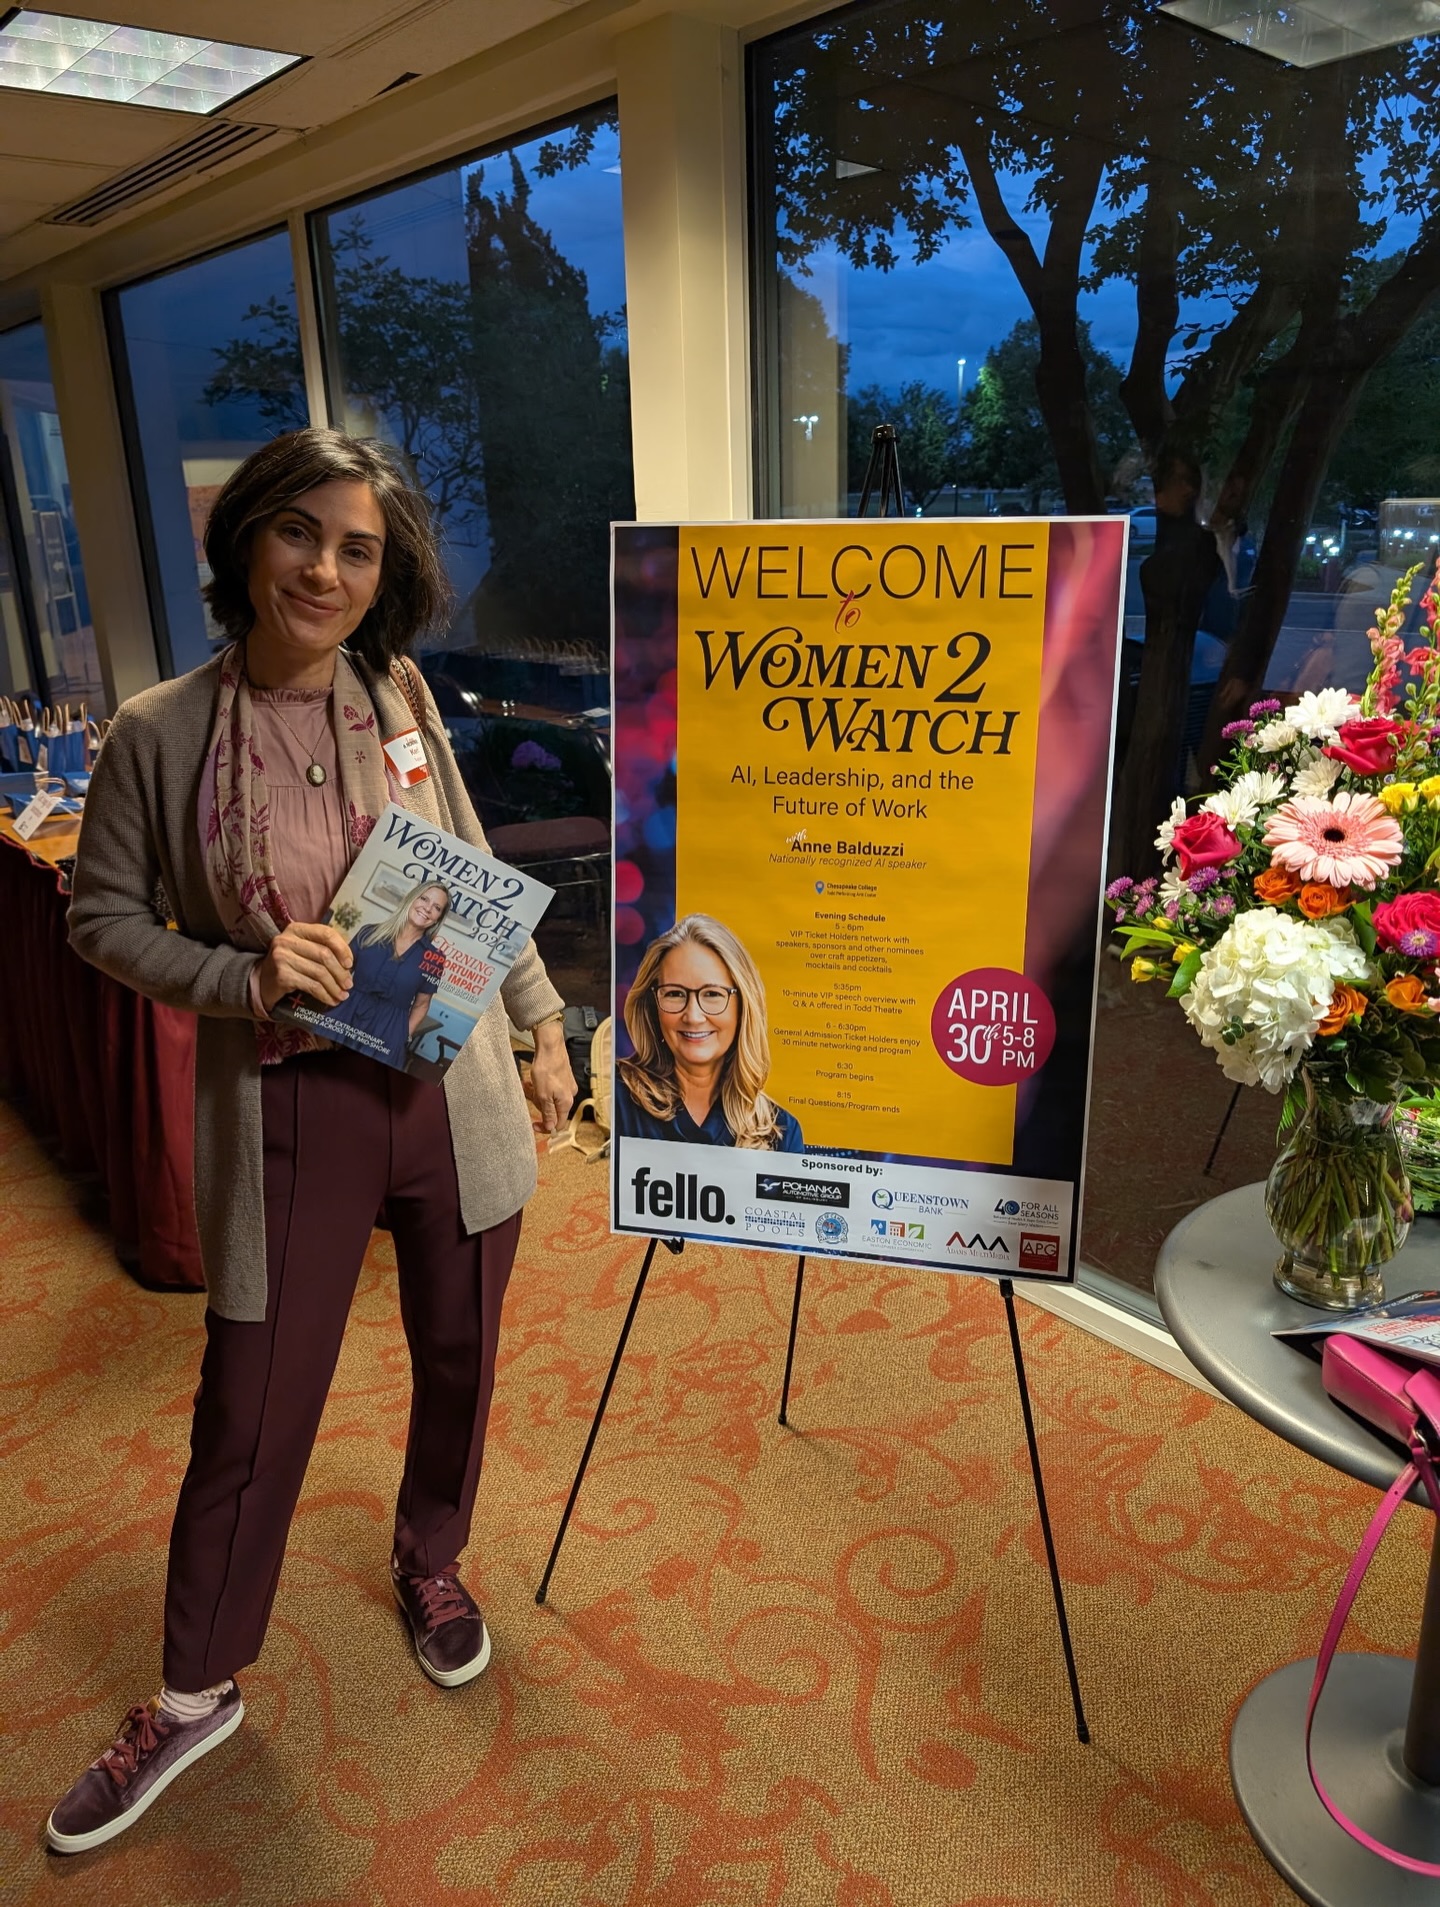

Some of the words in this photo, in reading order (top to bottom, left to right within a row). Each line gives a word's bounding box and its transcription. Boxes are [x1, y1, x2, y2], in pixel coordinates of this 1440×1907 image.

[691, 544, 1035, 599] WELCOME
[834, 590, 861, 634] to
[695, 627, 939, 691] WOMEN
[935, 632, 992, 703] 2
[762, 696, 1020, 756] WATCH
[730, 765, 757, 788] AI,
[764, 766, 884, 791] Leadership,
[892, 769, 932, 790] and
[939, 769, 974, 790] the
[773, 796, 839, 816] Future
[845, 797, 867, 817] of
[872, 798, 927, 819] Work
[786, 830, 808, 844] with
[791, 840, 832, 854] Anne
[837, 842, 904, 857] Balduzzi
[384, 813, 501, 893] WOMEN
[488, 878, 524, 911] 2
[769, 853, 816, 866] Nationally
[819, 857, 872, 868] recognized
[875, 858, 885, 867] AI
[887, 860, 926, 870] speaker
[815, 912, 847, 921] Evening
[849, 913, 886, 922] Schedule
[847, 924, 864, 932] 6pm
[469, 927, 506, 952] 2026
[805, 931, 827, 940] Ticket
[830, 933, 858, 941] Holders
[860, 935, 892, 943] network
[894, 936, 909, 944] with
[434, 936, 495, 976] TURNING
[776, 940, 810, 950] speakers,
[813, 942, 846, 951] sponsors
[865, 945, 884, 953] other
[887, 946, 924, 955] nominees
[828, 953, 845, 961] craft
[848, 954, 887, 964] appetizers,
[424, 950, 490, 986] OPPORTUNITY
[806, 962, 840, 971] mocktails
[843, 963, 856, 971] and
[858, 964, 892, 973] cocktails
[419, 961, 445, 978] INTO
[448, 974, 484, 995] IMPACT
[427, 975, 455, 994] HEATHER
[834, 983, 861, 992] 5:35pm
[782, 989, 818, 998] 10-minute
[820, 991, 833, 999] VIP
[835, 993, 862, 1002] speech
[864, 995, 897, 1004] overview
[899, 997, 915, 1005] with
[793, 1000, 799, 1008] Q
[816, 1001, 842, 1010] offered
[844, 1003, 852, 1011] in
[853, 1003, 871, 1012] Todd
[874, 1006, 902, 1014] Theatre
[948, 988, 1038, 1024] APRIL
[294, 1012, 319, 1024] WOMEN
[319, 1022, 343, 1034] ACROSS
[345, 1031, 358, 1040] THE
[357, 1037, 390, 1055] MID-SHORE
[297, 1006, 325, 1020] PROFILES
[335, 1021, 385, 1045] EXTRAORDINARY
[839, 1023, 866, 1032] 6:30pm
[774, 1028, 801, 1037] General
[804, 1030, 842, 1039] Admission
[845, 1032, 866, 1041] Ticket
[868, 1034, 897, 1044] Holders
[899, 1037, 920, 1047] enjoy
[1003, 1026, 1035, 1048] 5-8
[793, 1039, 818, 1047] minute
[820, 1041, 861, 1052] networking
[863, 1044, 877, 1053] and
[879, 1046, 911, 1056] program
[837, 1062, 853, 1070] 6:30
[1002, 1050, 1034, 1068] PM
[816, 1071, 848, 1081] Program
[849, 1073, 874, 1082] begins
[837, 1091, 851, 1099] 8:15
[789, 1096, 806, 1105] Final
[808, 1098, 880, 1112] Questions/Program
[882, 1105, 900, 1113] ends
[801, 1158, 863, 1174] Sponsored
[866, 1165, 883, 1177] by:
[632, 1167, 735, 1225] fello.
[782, 1182, 841, 1195] POHANKA
[872, 1188, 969, 1210] QUEENSTOWN
[1021, 1202, 1040, 1210] FOR
[1043, 1203, 1058, 1212] ALL
[745, 1206, 805, 1221] COASTAL
[919, 1206, 943, 1215] BANK
[1021, 1211, 1058, 1220] SEASONS
[745, 1223, 805, 1237] POOLS
[862, 1235, 890, 1245] EASTON
[893, 1239, 931, 1249] ECONOMIC
[1023, 1241, 1056, 1255] APG
